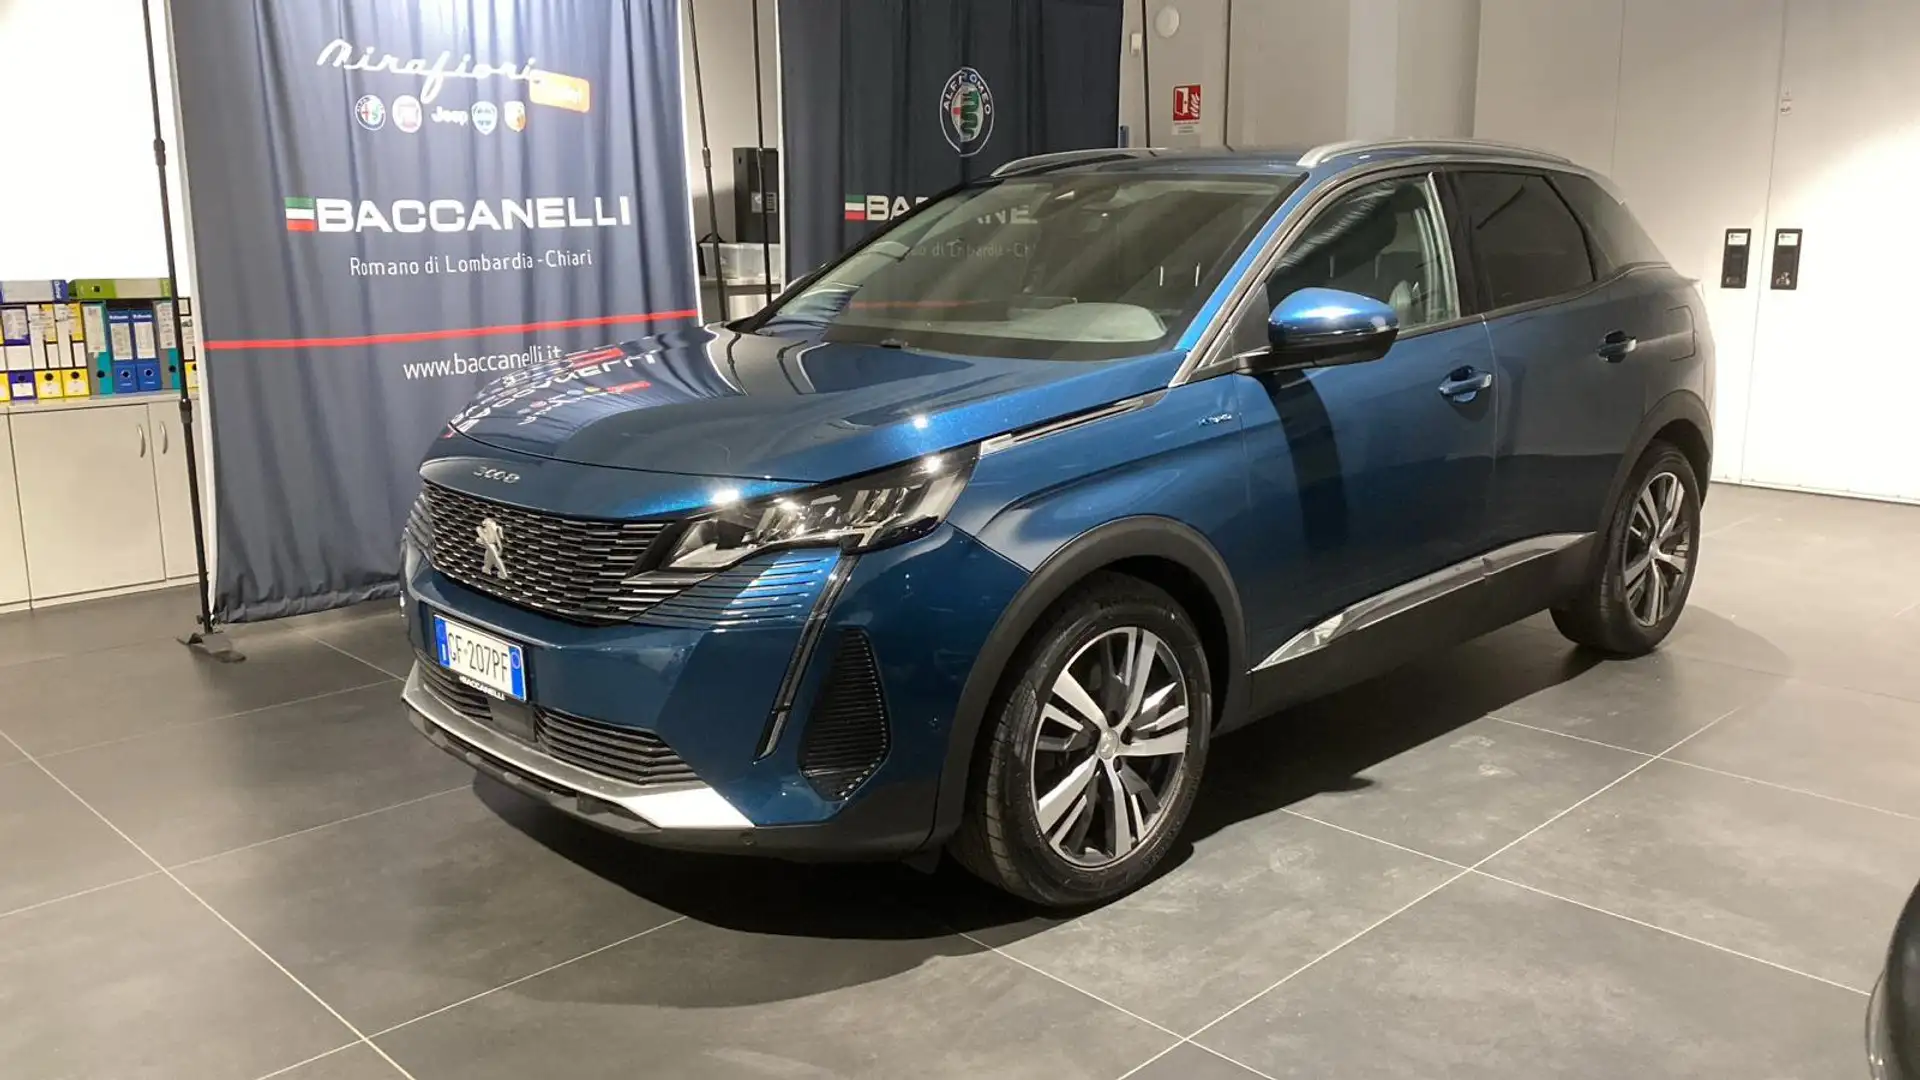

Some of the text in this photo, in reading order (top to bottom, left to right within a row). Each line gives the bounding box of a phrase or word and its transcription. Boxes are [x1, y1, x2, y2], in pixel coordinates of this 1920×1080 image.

[316, 38, 537, 104] Mirafiori
[316, 196, 632, 233] BACCANELLI
[350, 257, 420, 276] Romano
[425, 256, 440, 274] di
[445, 252, 534, 273] Lombardia
[403, 345, 562, 380] www.baccanelli.it
[472, 466, 520, 484] 3008
